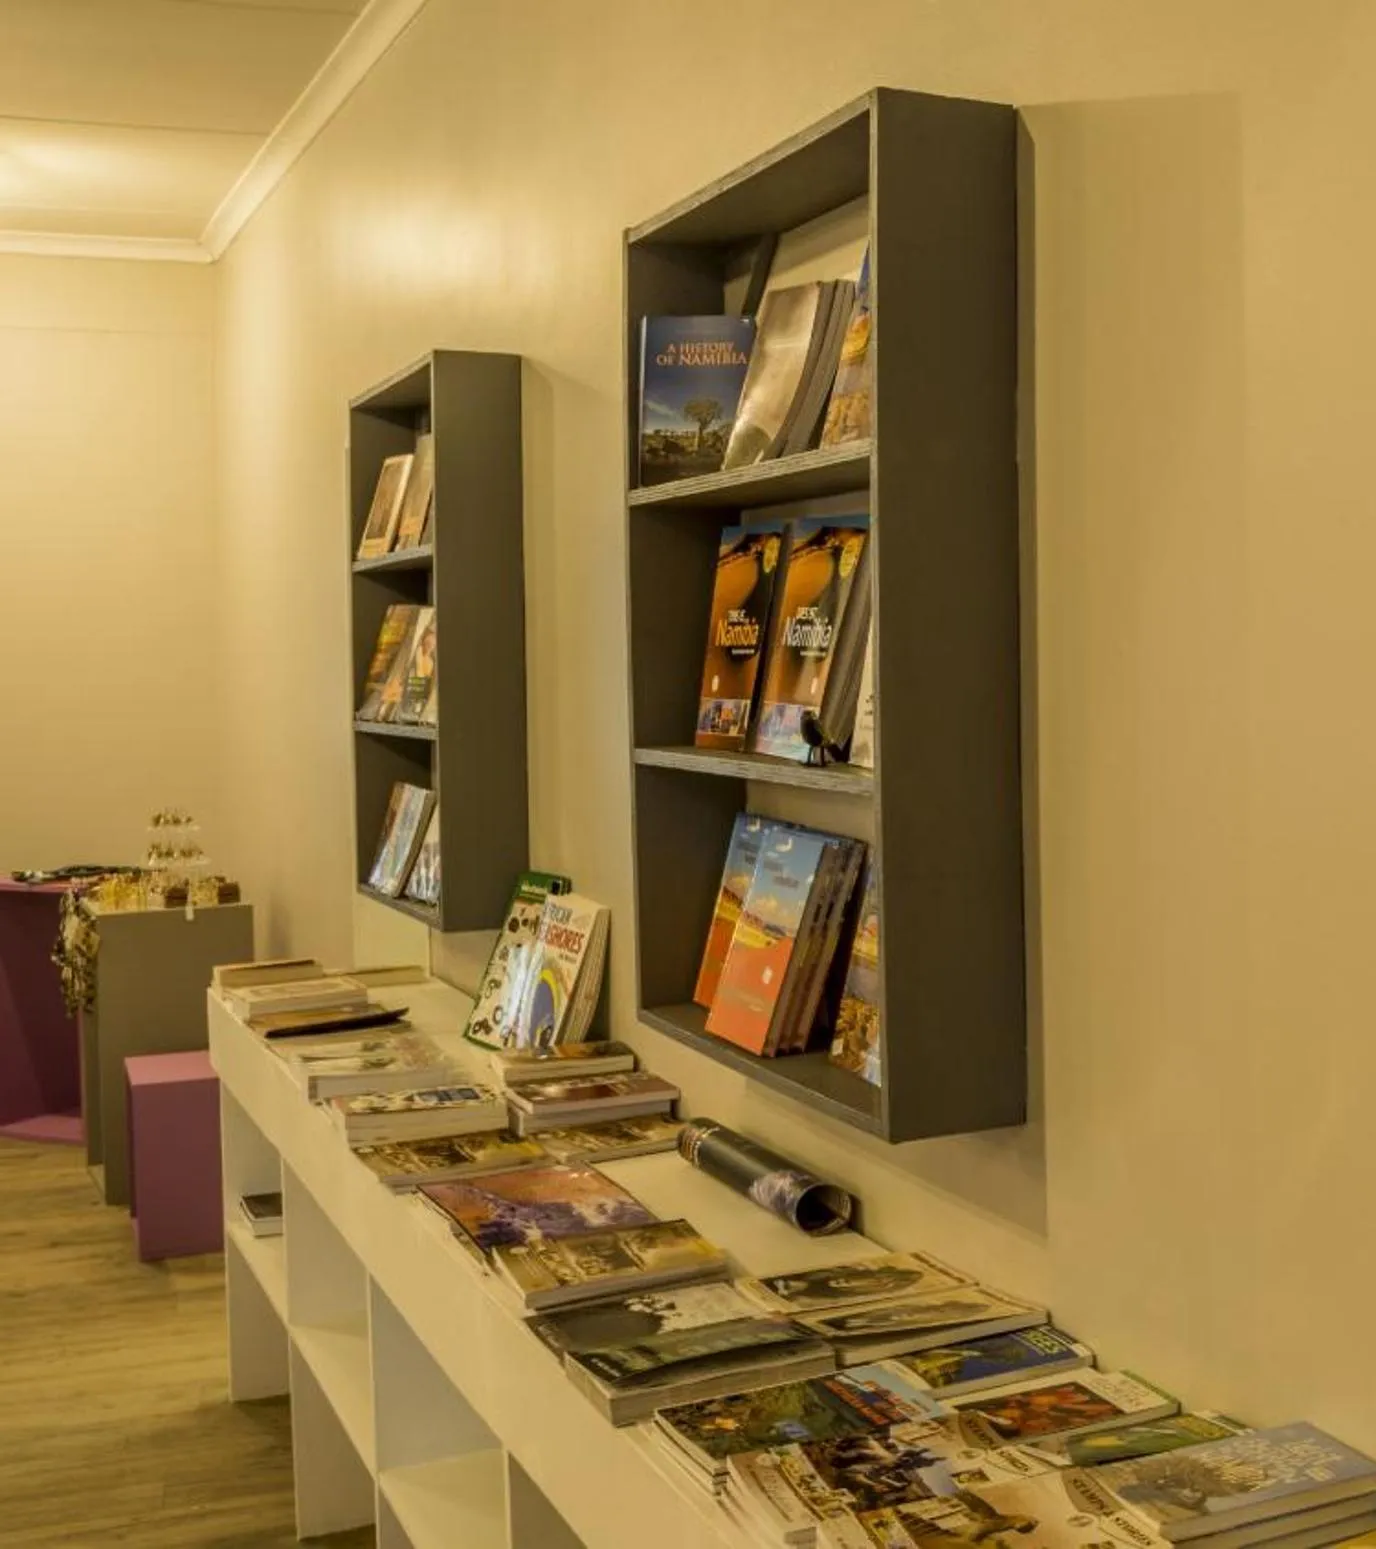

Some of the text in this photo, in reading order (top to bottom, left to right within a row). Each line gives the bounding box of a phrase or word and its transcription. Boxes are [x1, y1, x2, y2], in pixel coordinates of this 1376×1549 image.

[680, 341, 735, 354] HISTORY
[656, 351, 748, 367] OF NAMIBIA
